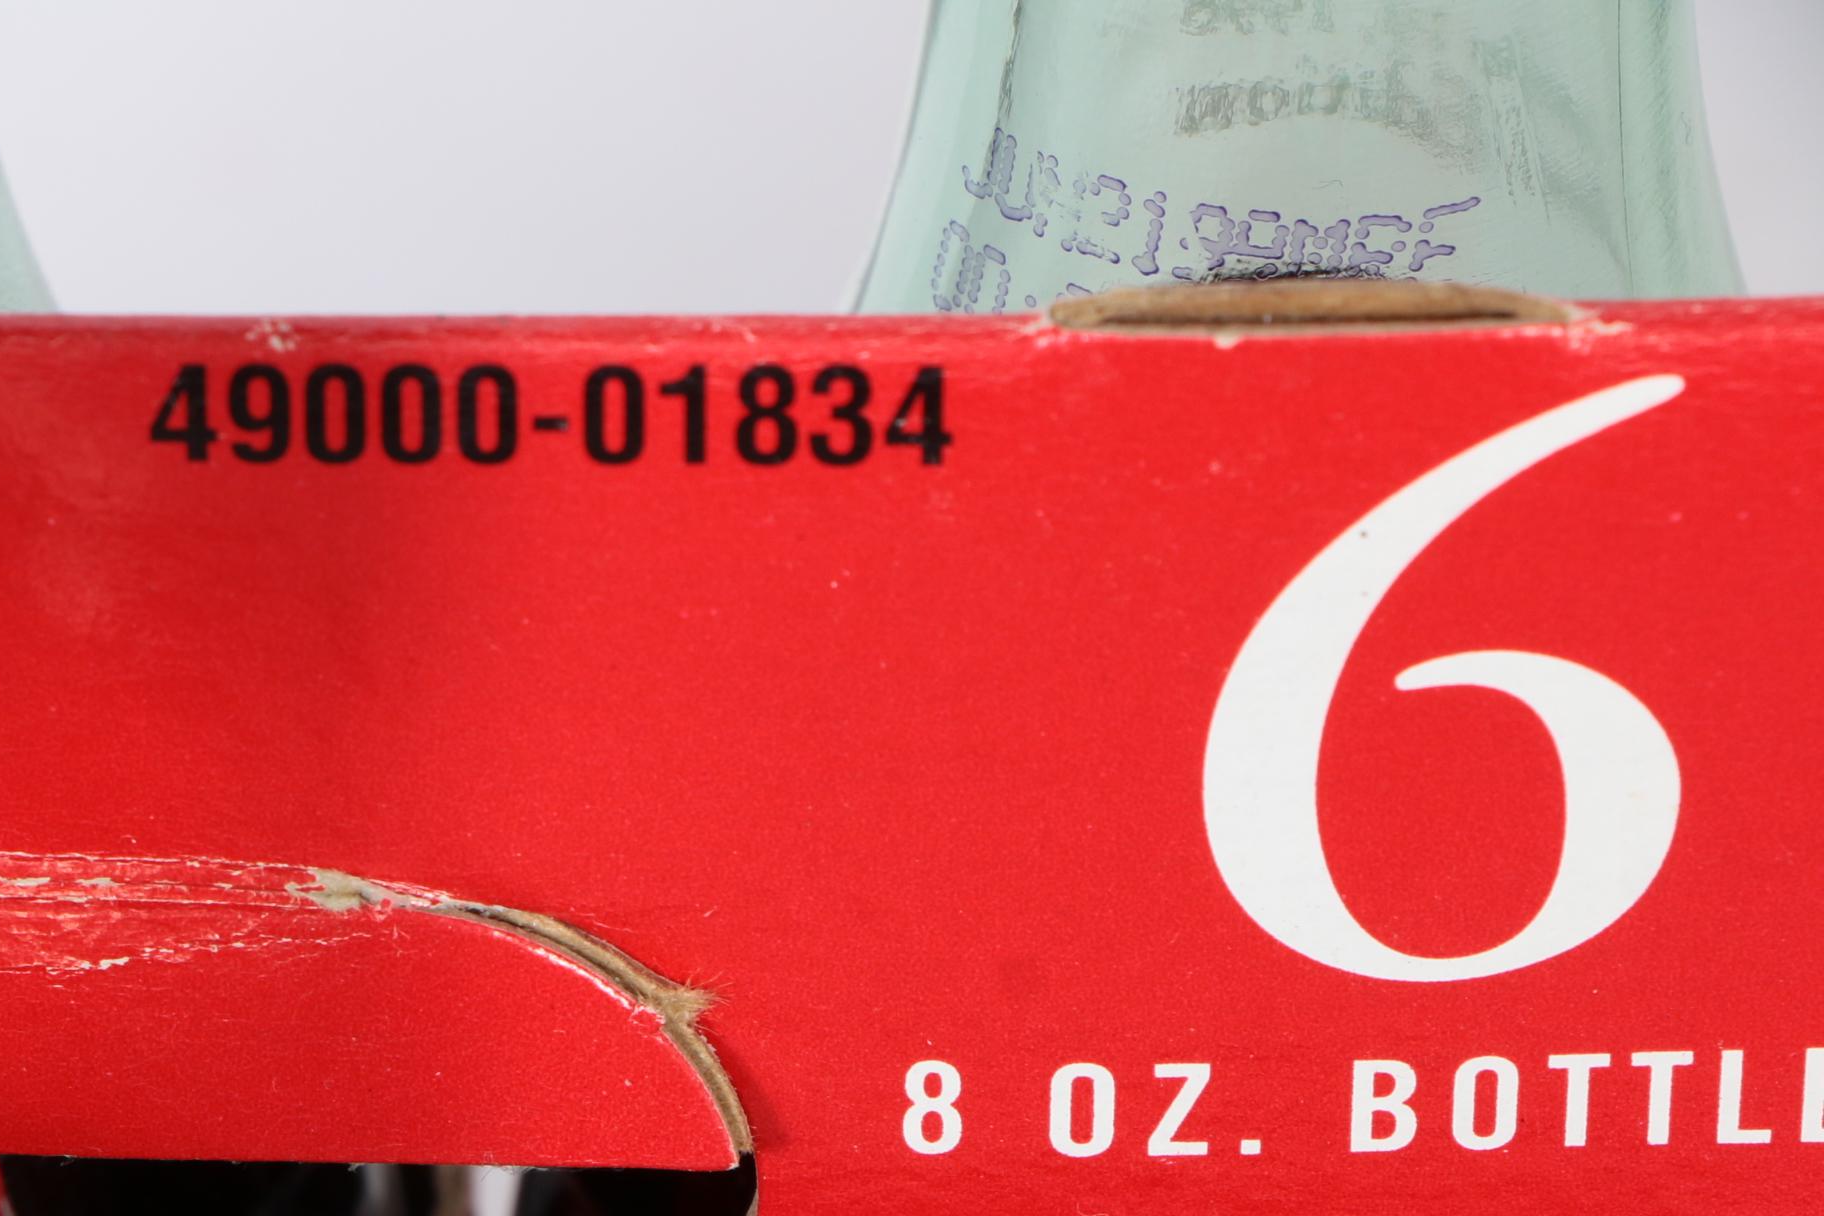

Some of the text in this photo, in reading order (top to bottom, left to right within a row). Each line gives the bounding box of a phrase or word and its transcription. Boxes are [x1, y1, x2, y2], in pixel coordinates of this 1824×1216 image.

[149, 362, 954, 467] 49000-01834
[1202, 373, 1686, 983] 6
[901, 1047, 1824, 1158] 8 OZ. BOTTL
